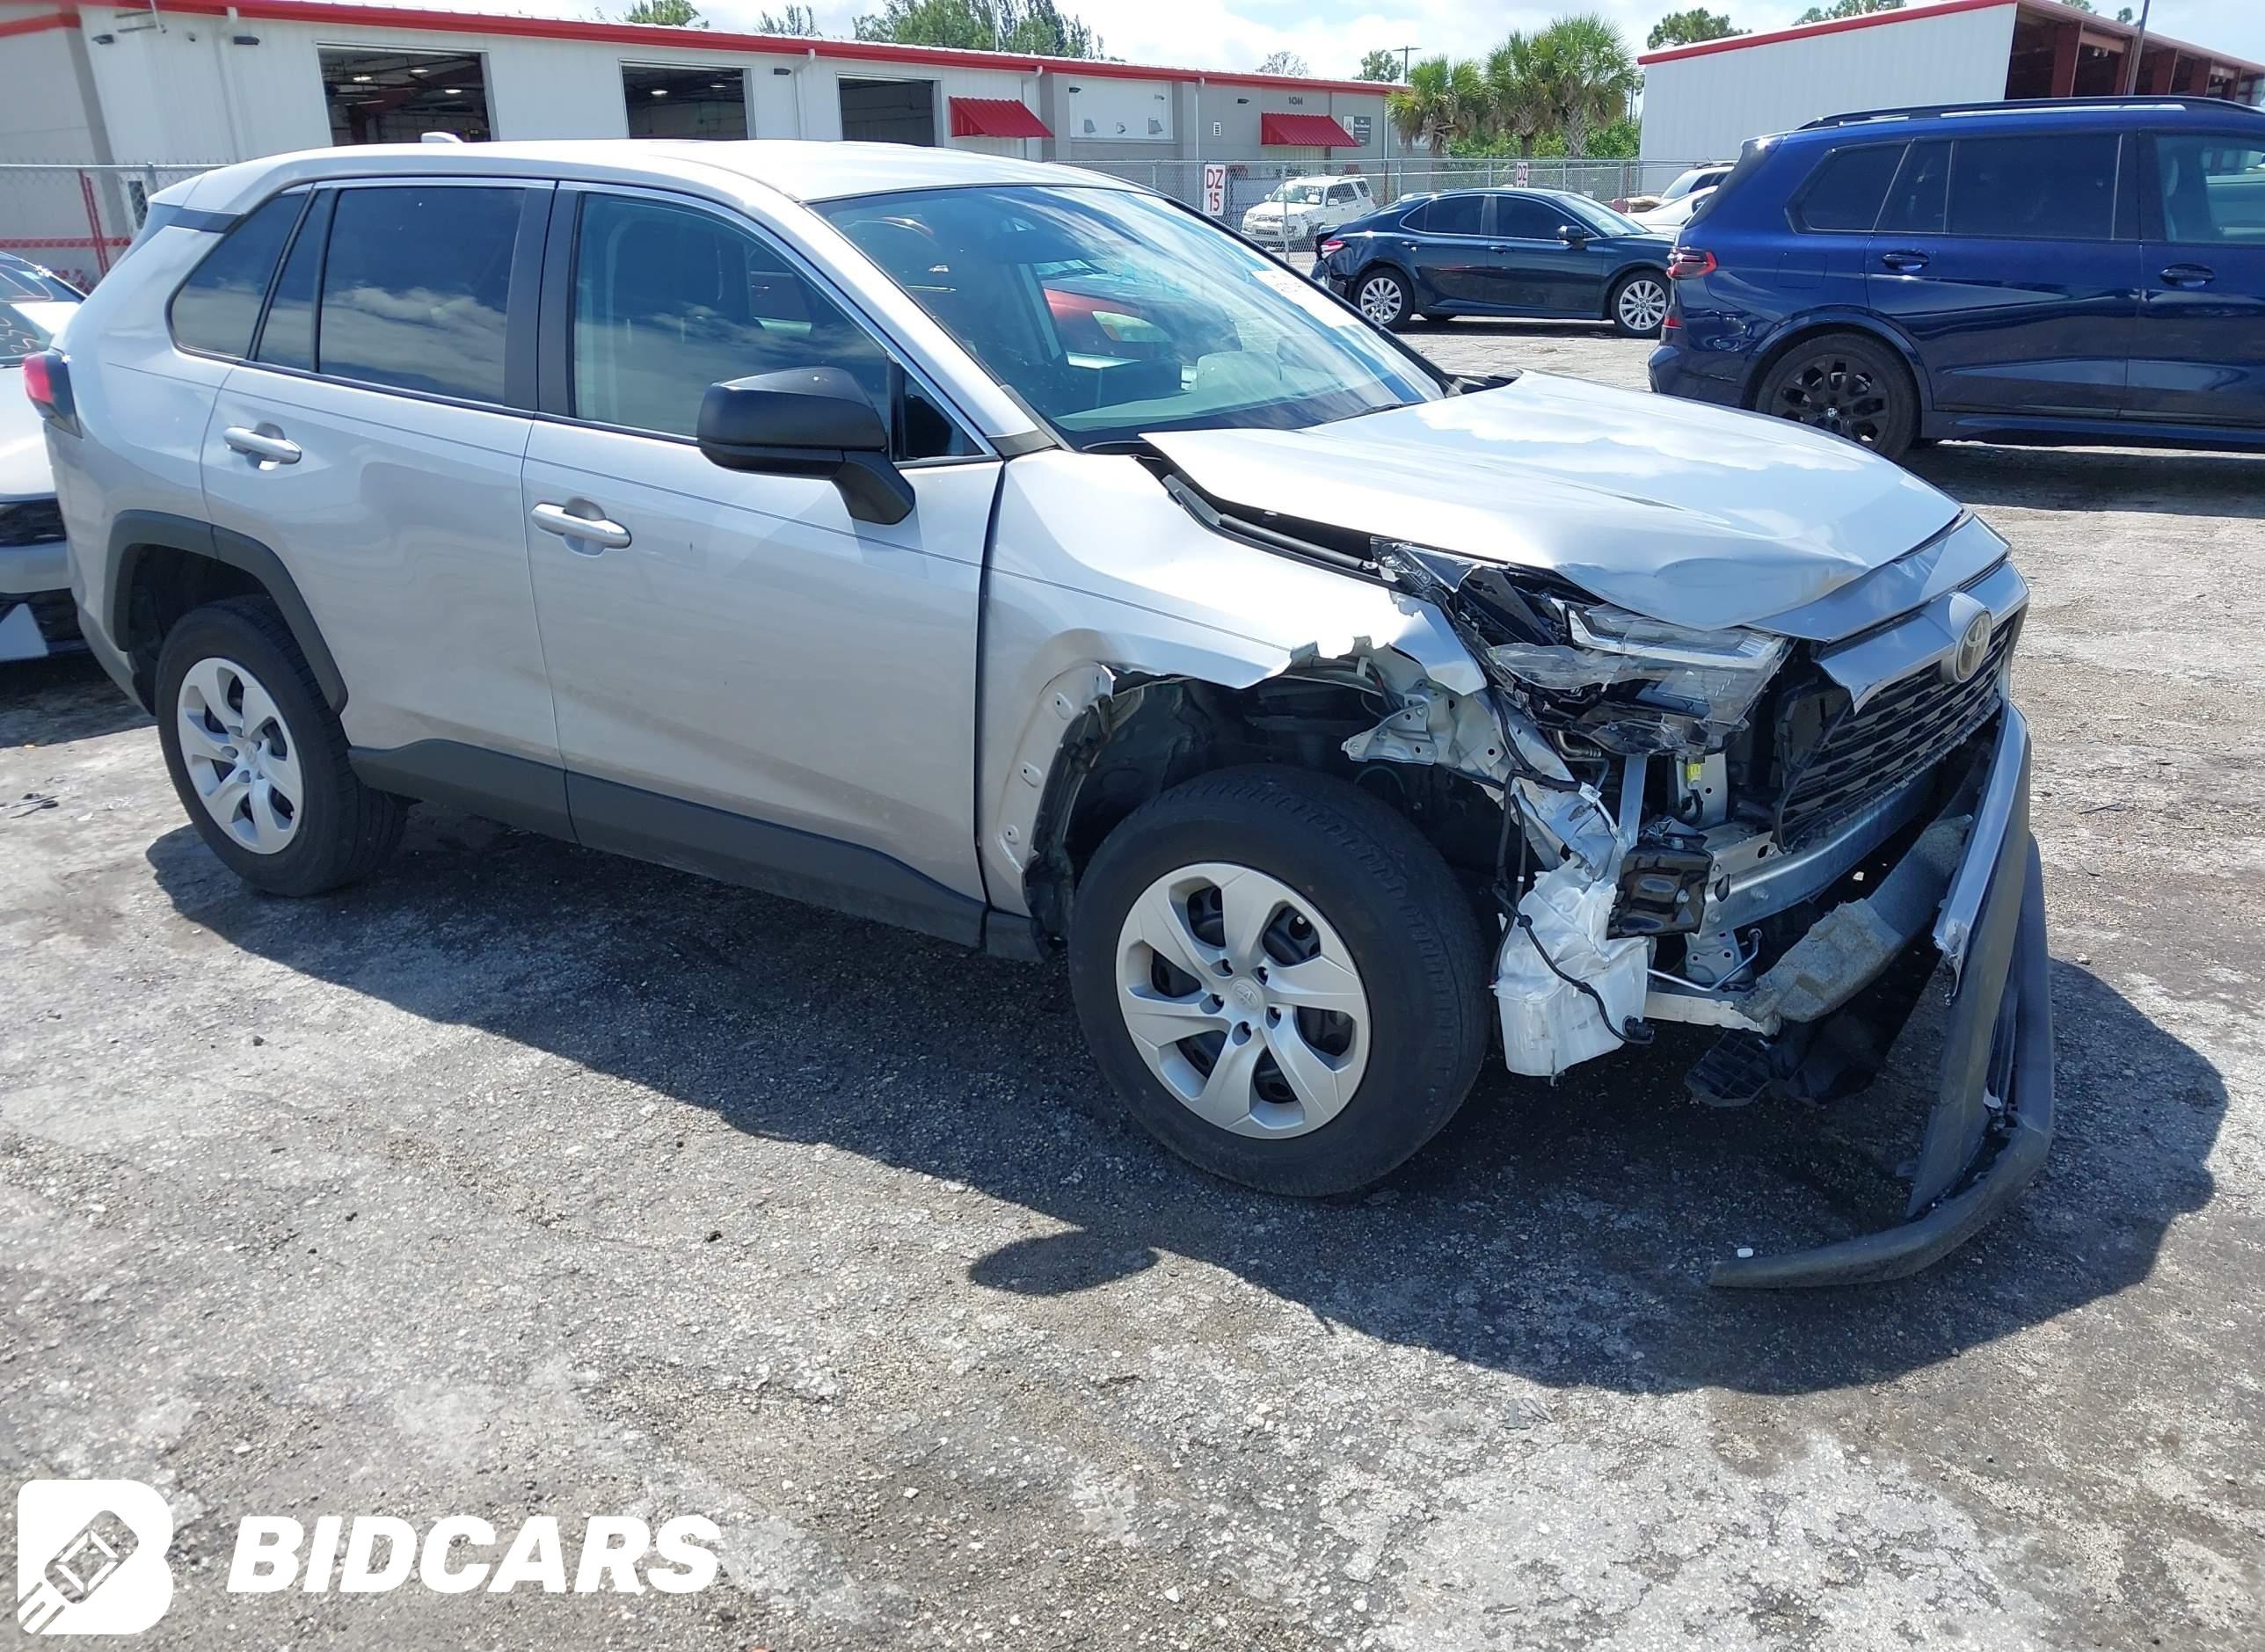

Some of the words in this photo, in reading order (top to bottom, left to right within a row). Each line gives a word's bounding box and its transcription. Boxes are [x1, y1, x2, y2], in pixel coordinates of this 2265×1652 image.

[1205, 168, 1224, 190] DZ
[1518, 164, 1527, 181] DZ
[1208, 192, 1220, 212] 15
